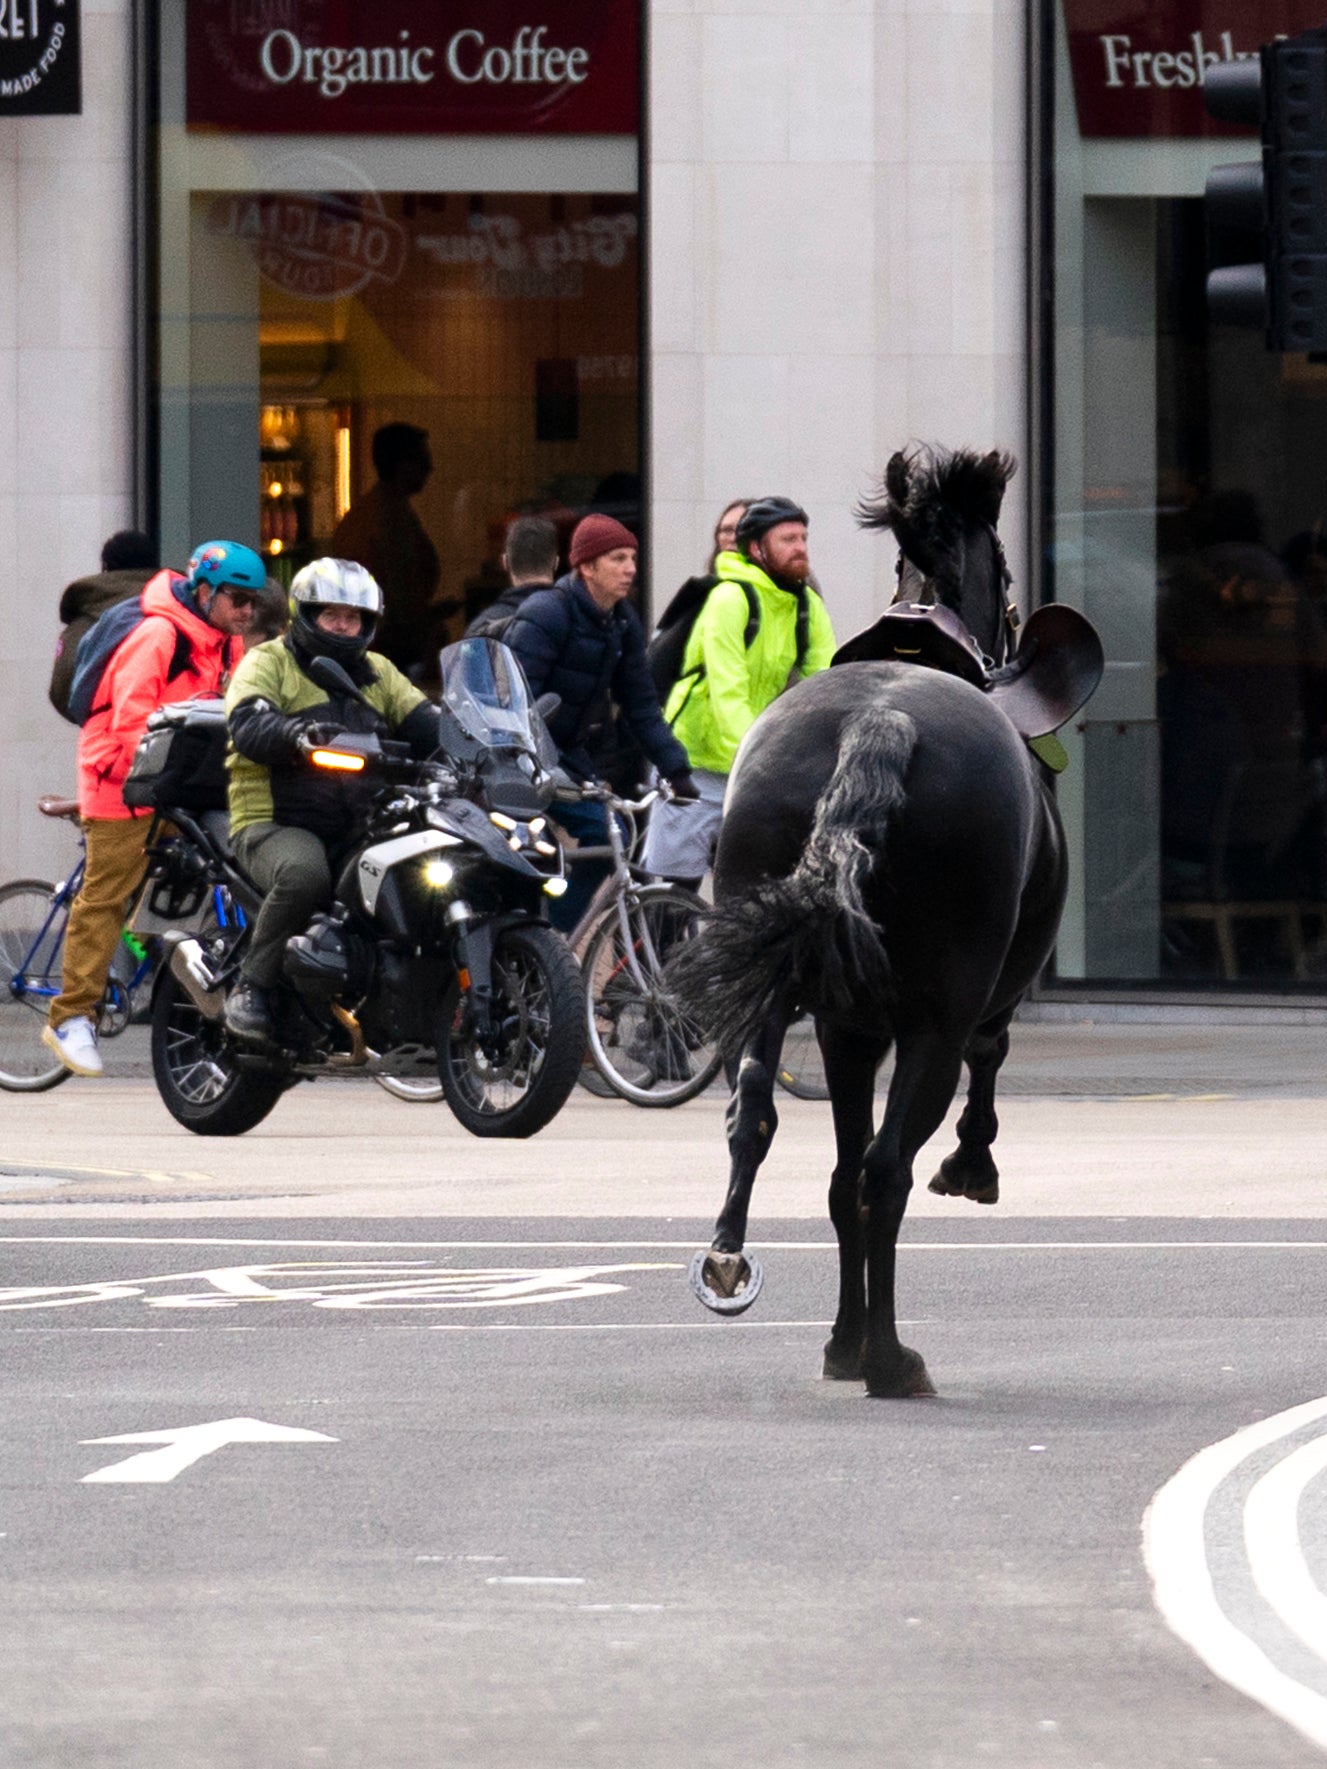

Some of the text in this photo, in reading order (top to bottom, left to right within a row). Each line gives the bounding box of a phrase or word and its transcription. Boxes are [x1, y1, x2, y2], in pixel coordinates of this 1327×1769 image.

[1, 22, 66, 97] MADE FOOD
[261, 29, 434, 97] Organic
[449, 26, 589, 84] Coffee
[1100, 30, 1261, 88] Freshl
[360, 860, 381, 877] GS
